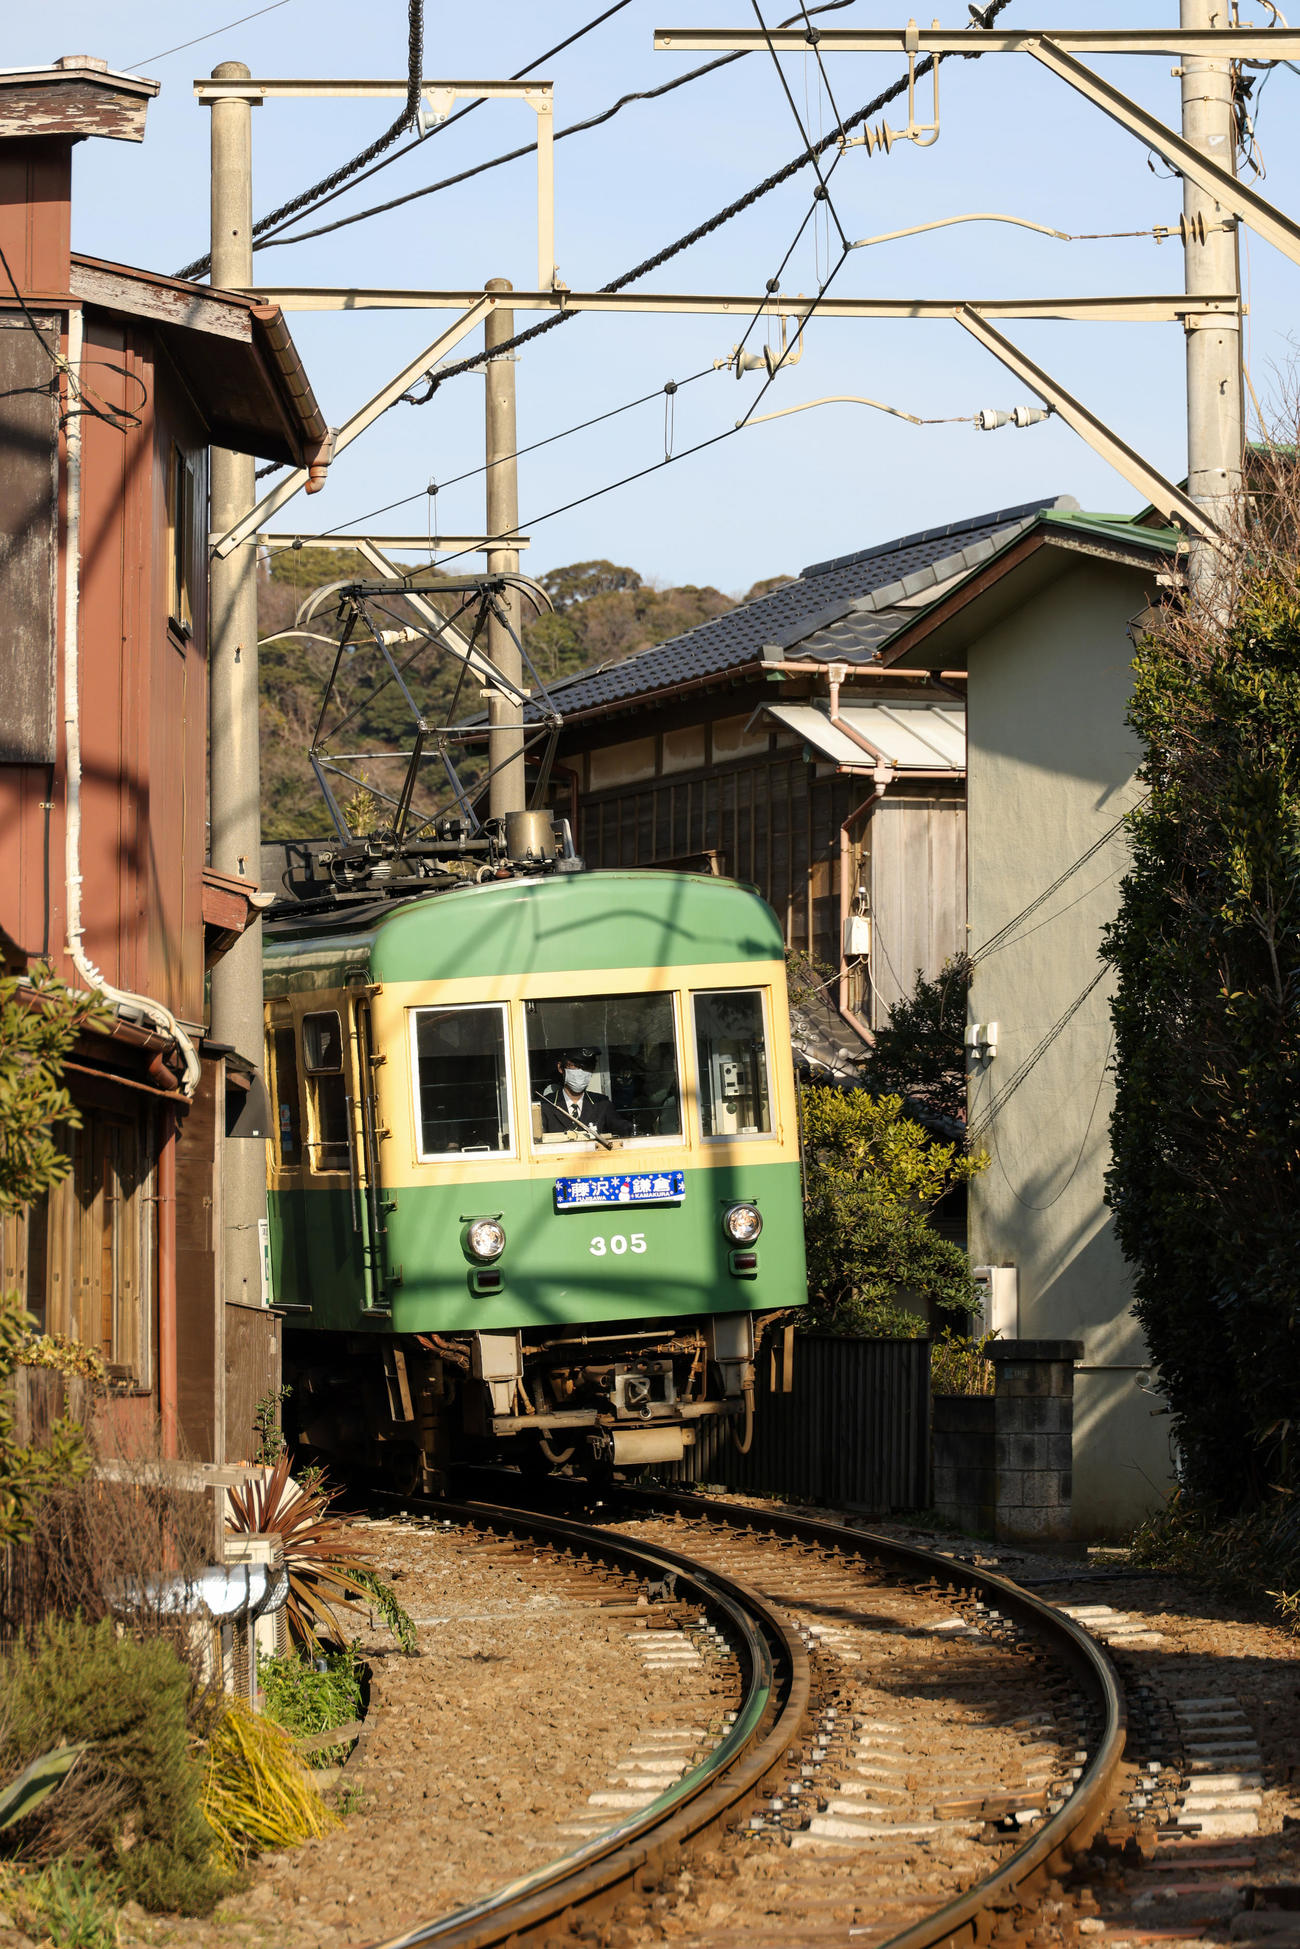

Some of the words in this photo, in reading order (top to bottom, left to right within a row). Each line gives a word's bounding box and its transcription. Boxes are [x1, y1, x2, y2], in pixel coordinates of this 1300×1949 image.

[571, 1181, 610, 1198] 藤沢
[632, 1177, 671, 1193] 鎌倉
[635, 1191, 671, 1199] KAMAKURA
[589, 1233, 647, 1256] 305
